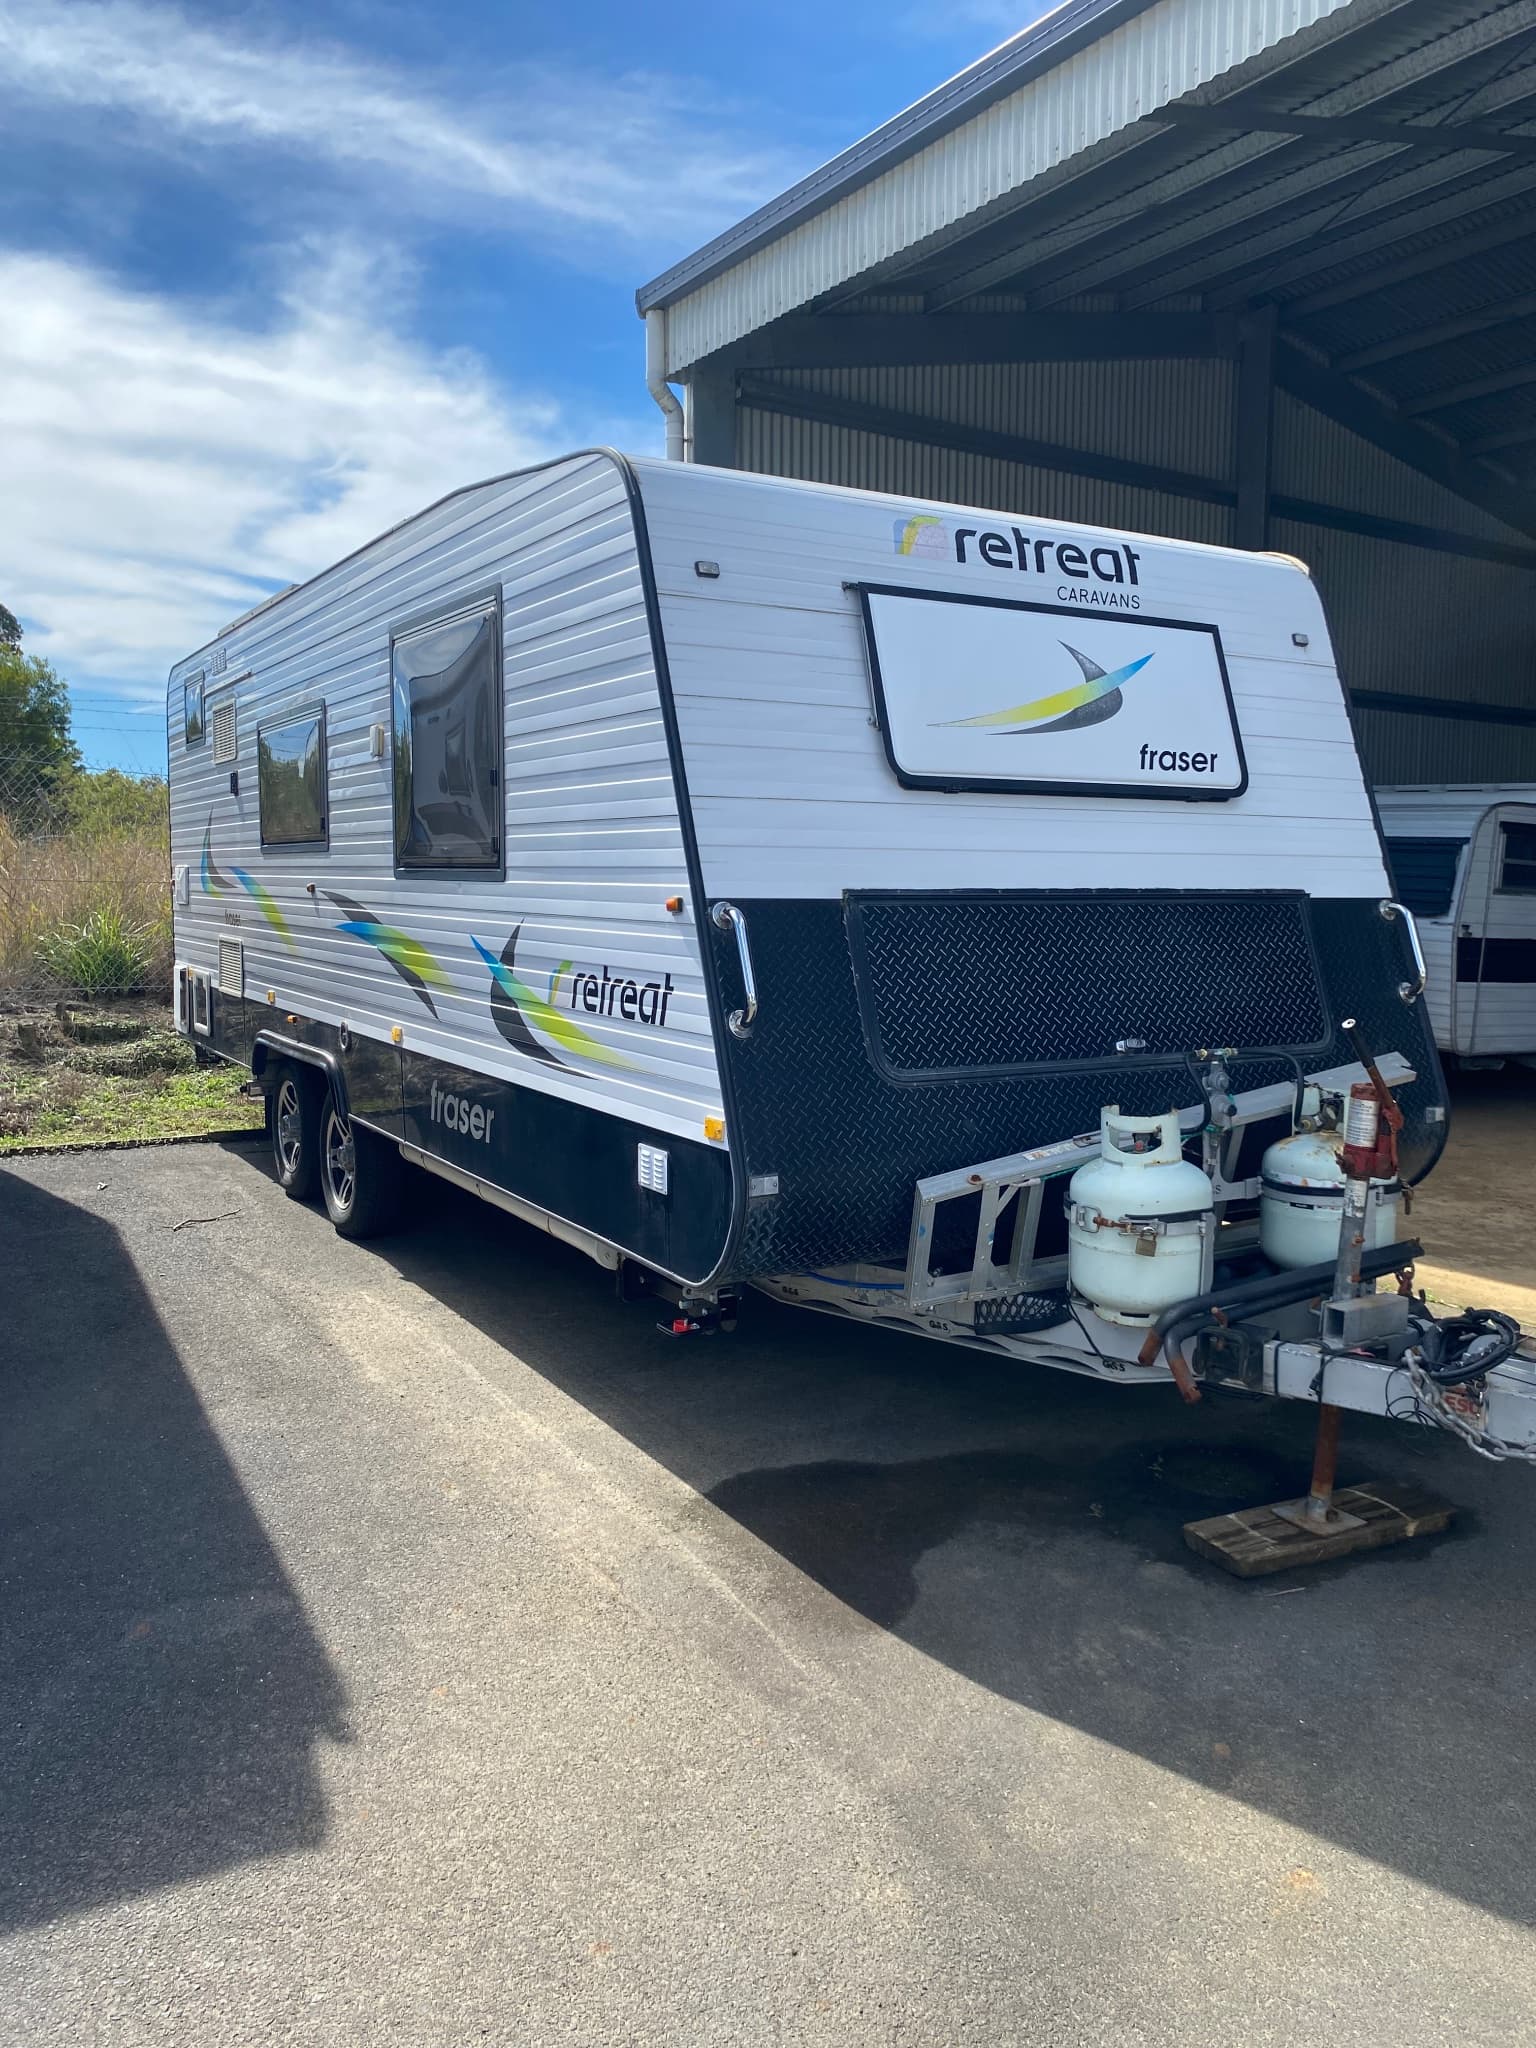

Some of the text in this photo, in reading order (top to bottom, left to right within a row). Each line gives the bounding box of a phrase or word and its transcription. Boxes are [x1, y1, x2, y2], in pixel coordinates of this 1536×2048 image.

[955, 527, 1141, 585] retreat
[1057, 586, 1140, 609] CARAVANS
[1139, 743, 1218, 773] fraser
[571, 965, 675, 1026] retreat
[430, 1080, 495, 1144] fraser
